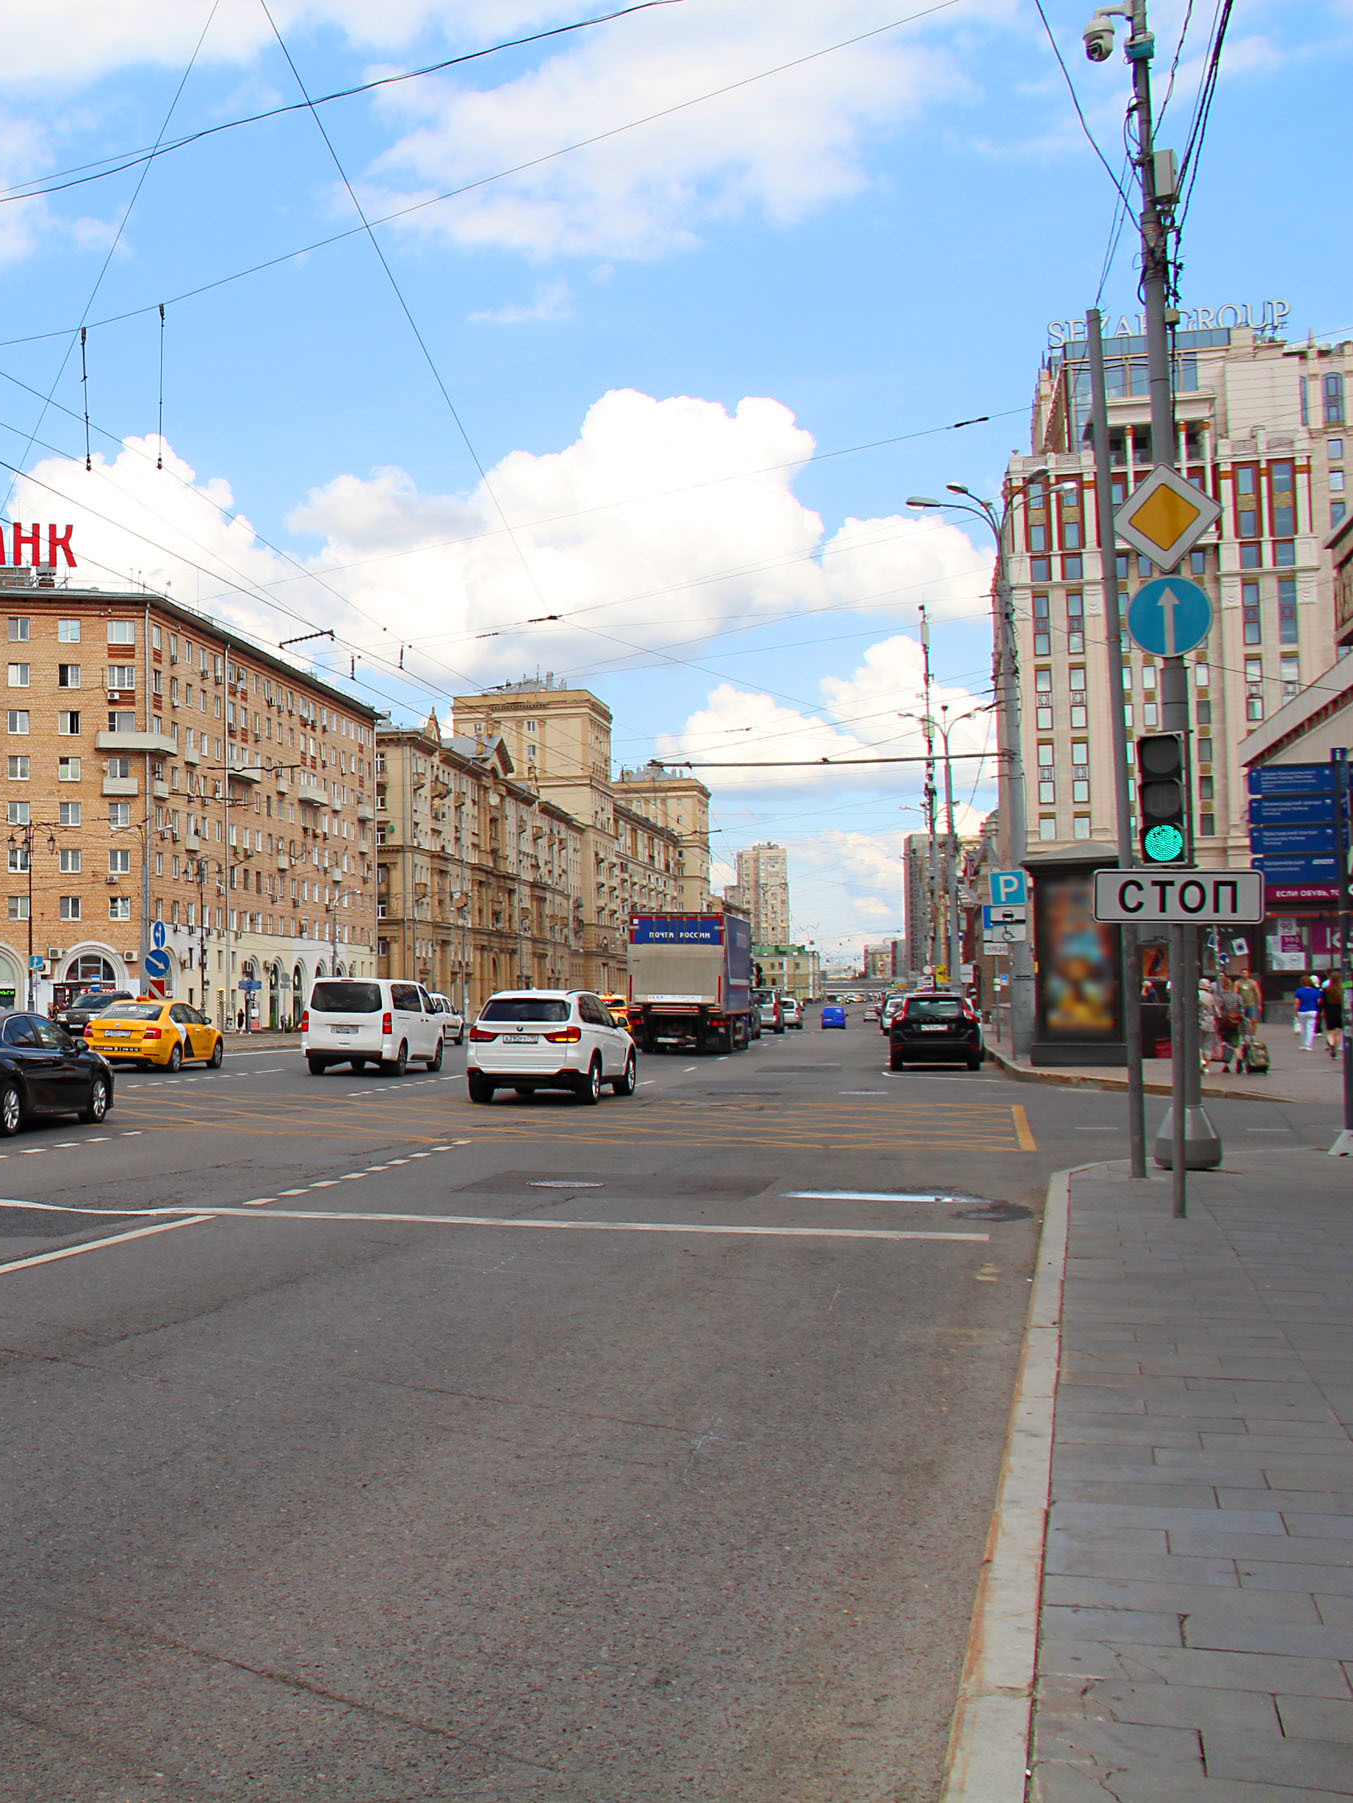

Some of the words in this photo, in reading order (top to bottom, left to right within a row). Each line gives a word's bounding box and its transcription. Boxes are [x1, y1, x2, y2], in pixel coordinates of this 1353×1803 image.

[998, 875, 1019, 902] P
[1118, 879, 1238, 914] СТОП
[679, 931, 711, 939] РОССИИ
